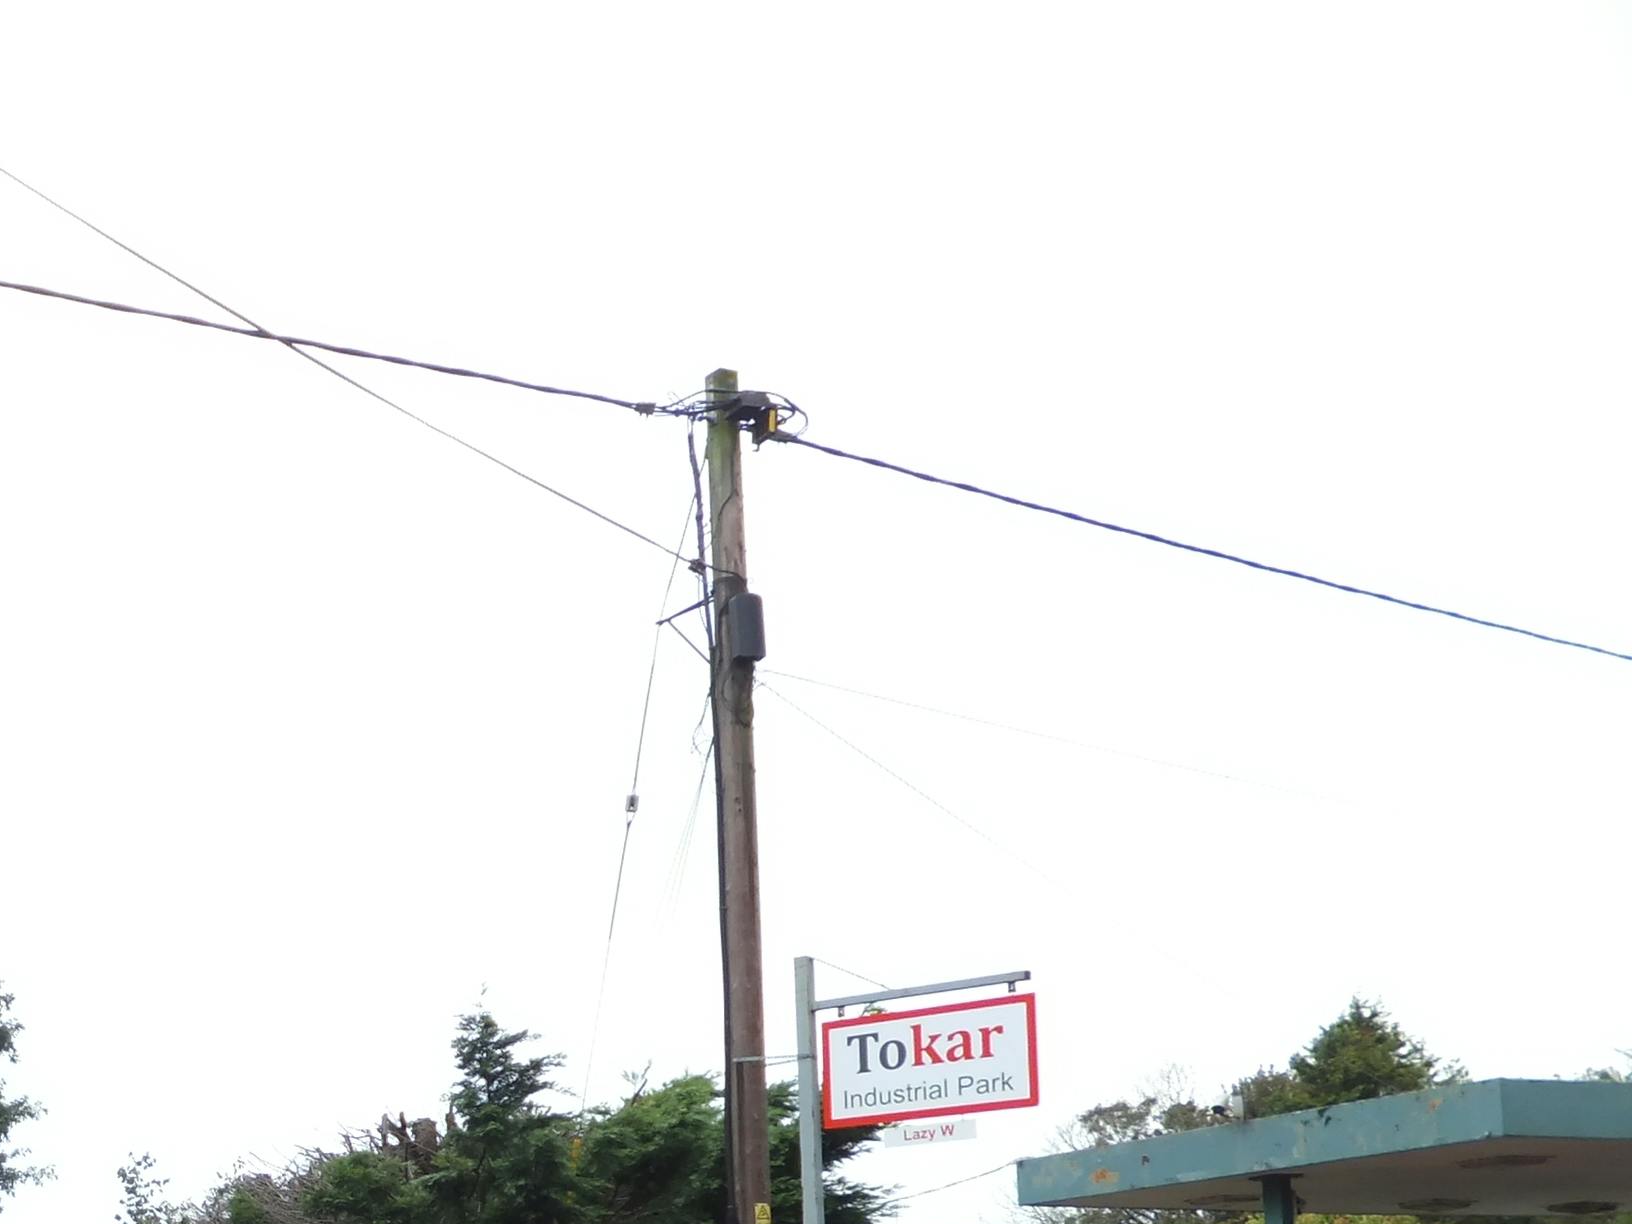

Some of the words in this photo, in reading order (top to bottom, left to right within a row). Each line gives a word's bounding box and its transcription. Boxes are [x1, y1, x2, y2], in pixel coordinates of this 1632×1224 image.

[847, 1024, 1004, 1074] Tokar
[844, 1079, 948, 1109] Industrial
[958, 1072, 1014, 1096] Park
[903, 1127, 936, 1141] Lazy
[940, 1125, 955, 1137] W
